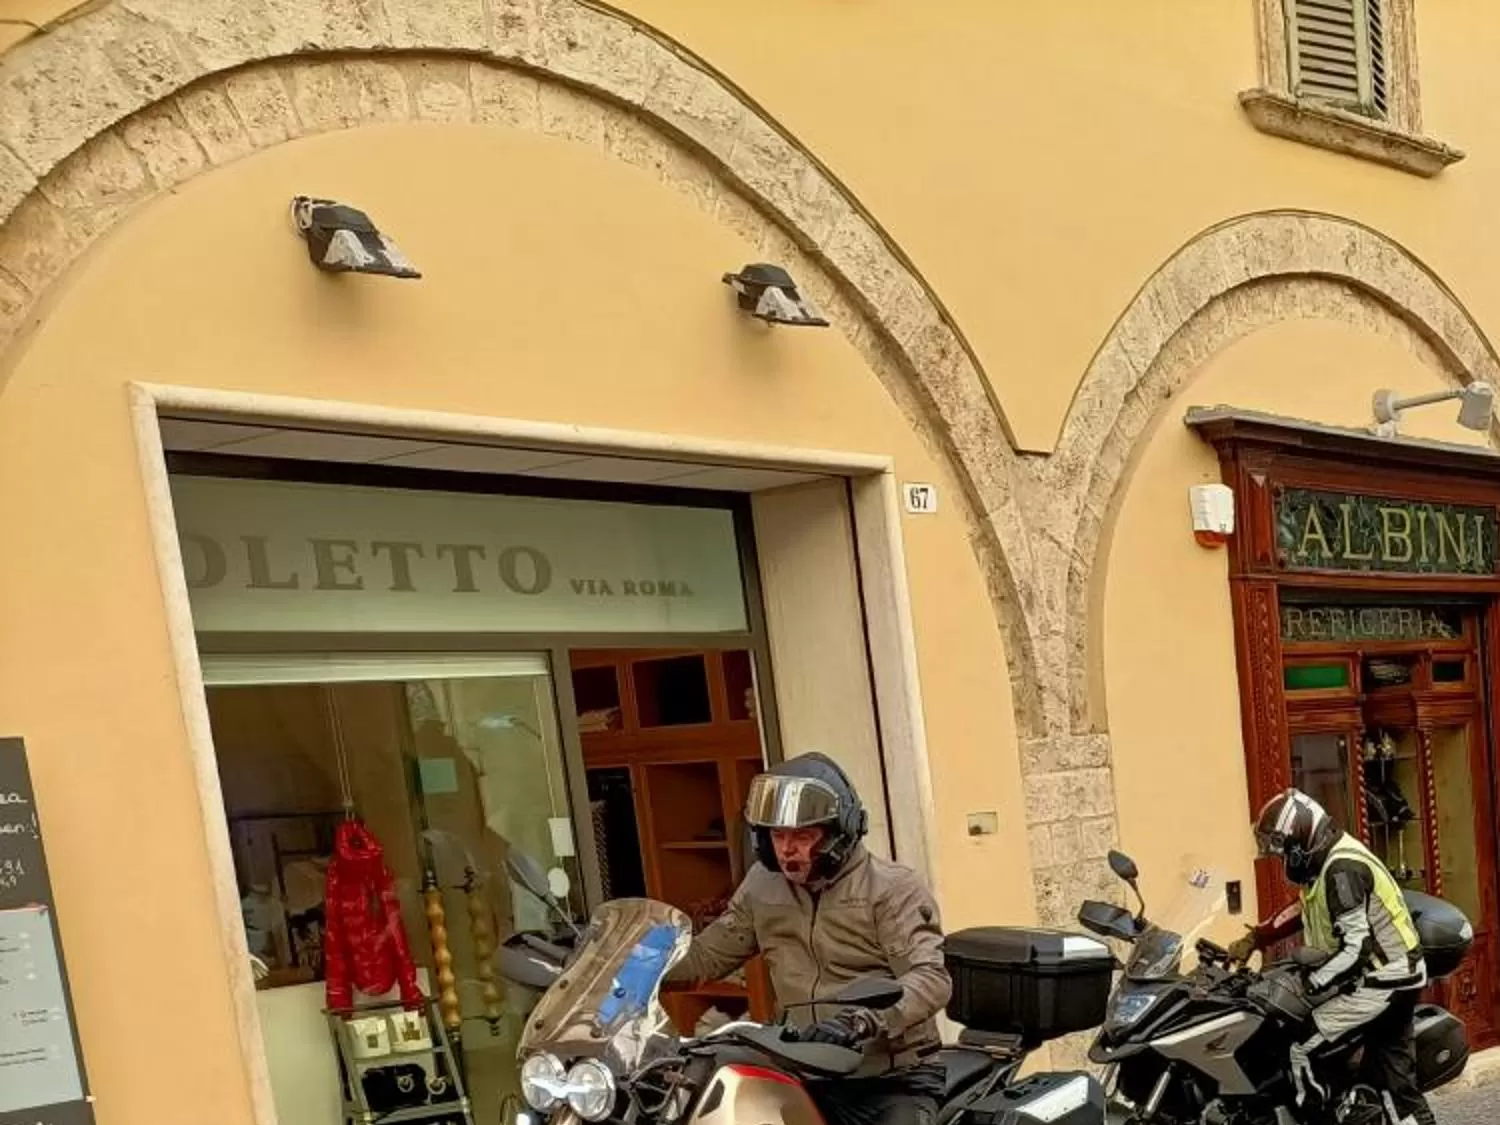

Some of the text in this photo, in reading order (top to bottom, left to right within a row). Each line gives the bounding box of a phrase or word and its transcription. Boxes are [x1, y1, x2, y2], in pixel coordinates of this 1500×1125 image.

[909, 487, 929, 509] 67
[1297, 502, 1486, 567] ALBINI
[569, 578, 615, 597] VIA
[623, 578, 695, 598] ROMA
